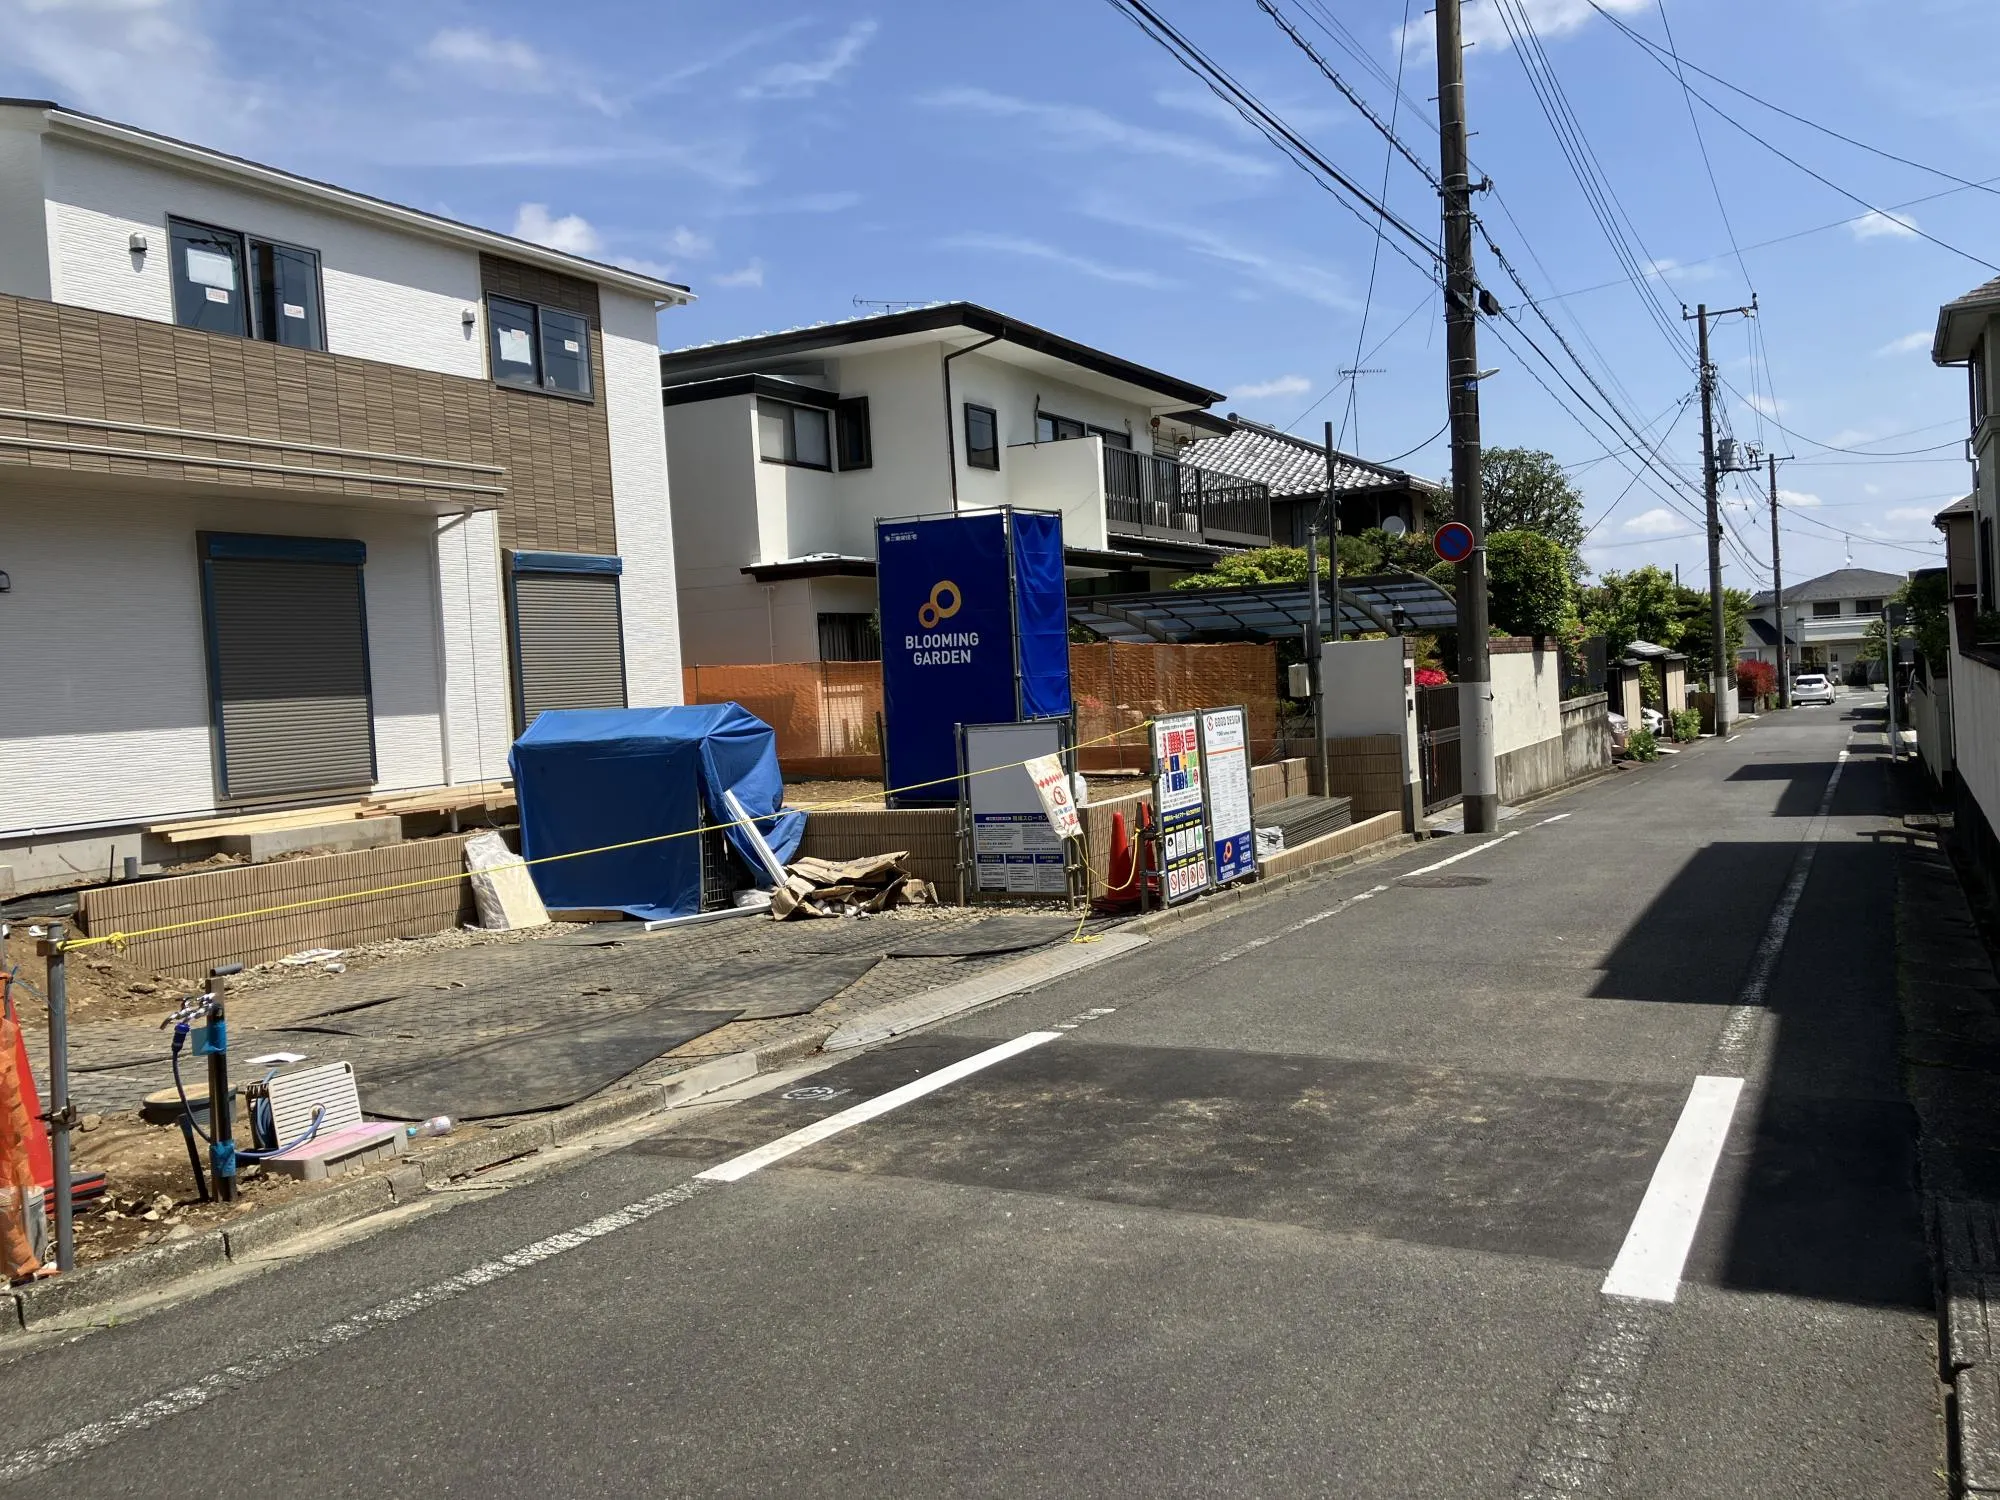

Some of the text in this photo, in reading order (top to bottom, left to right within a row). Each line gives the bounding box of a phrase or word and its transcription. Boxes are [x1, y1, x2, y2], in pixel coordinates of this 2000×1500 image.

[905, 632, 979, 650] BLOOMING
[913, 649, 971, 666] GARDEN
[1214, 714, 1241, 727] GOOD DESIGN
